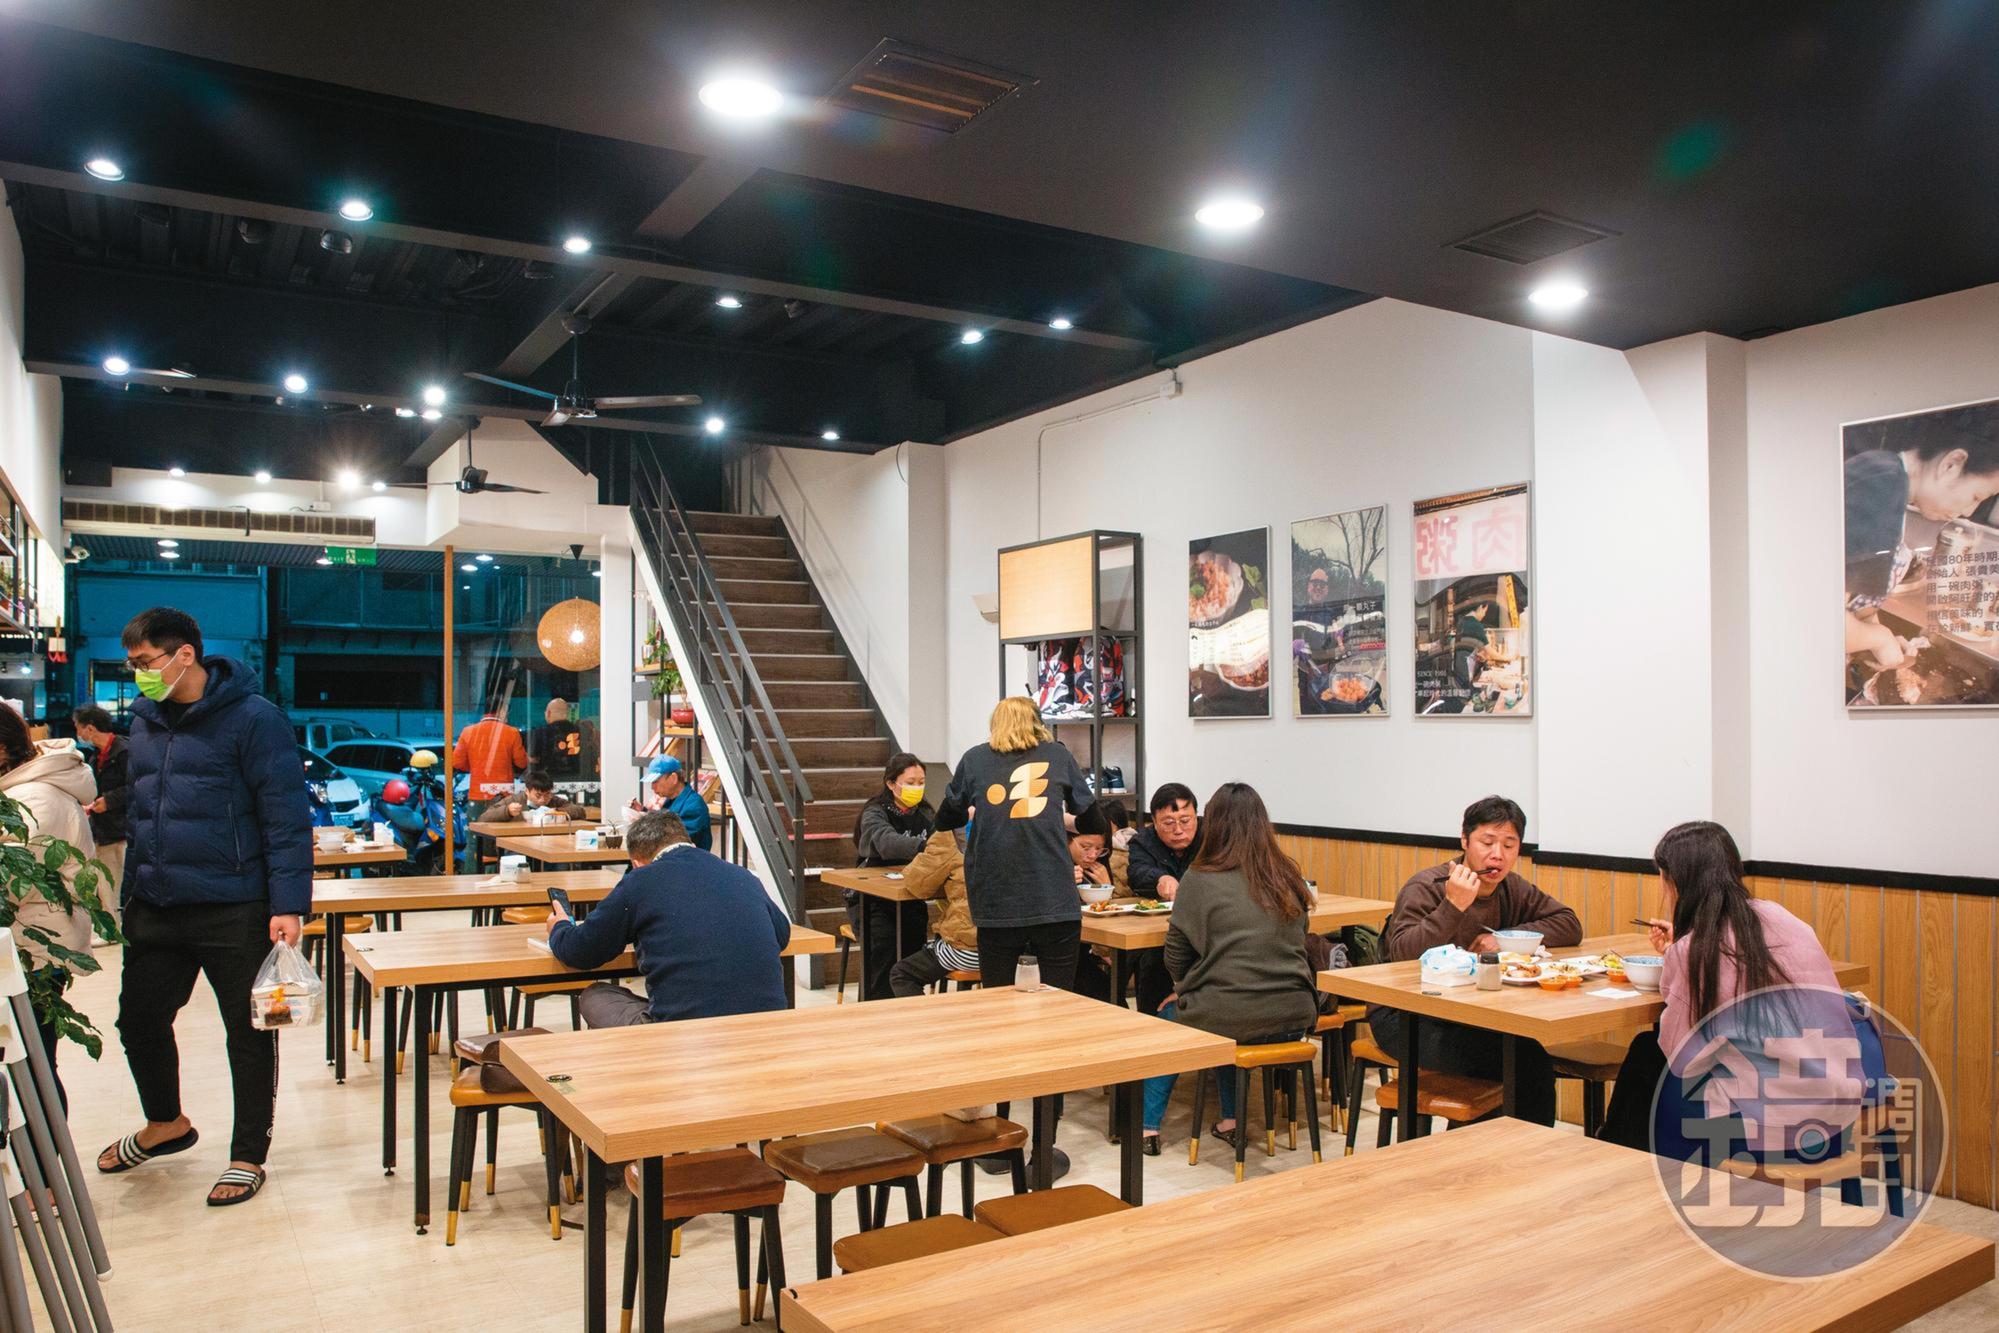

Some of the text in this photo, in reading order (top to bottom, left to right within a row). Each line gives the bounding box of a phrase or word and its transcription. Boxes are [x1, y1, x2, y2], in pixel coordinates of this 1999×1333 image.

[1926, 551, 1999, 567] 民國80年時期
